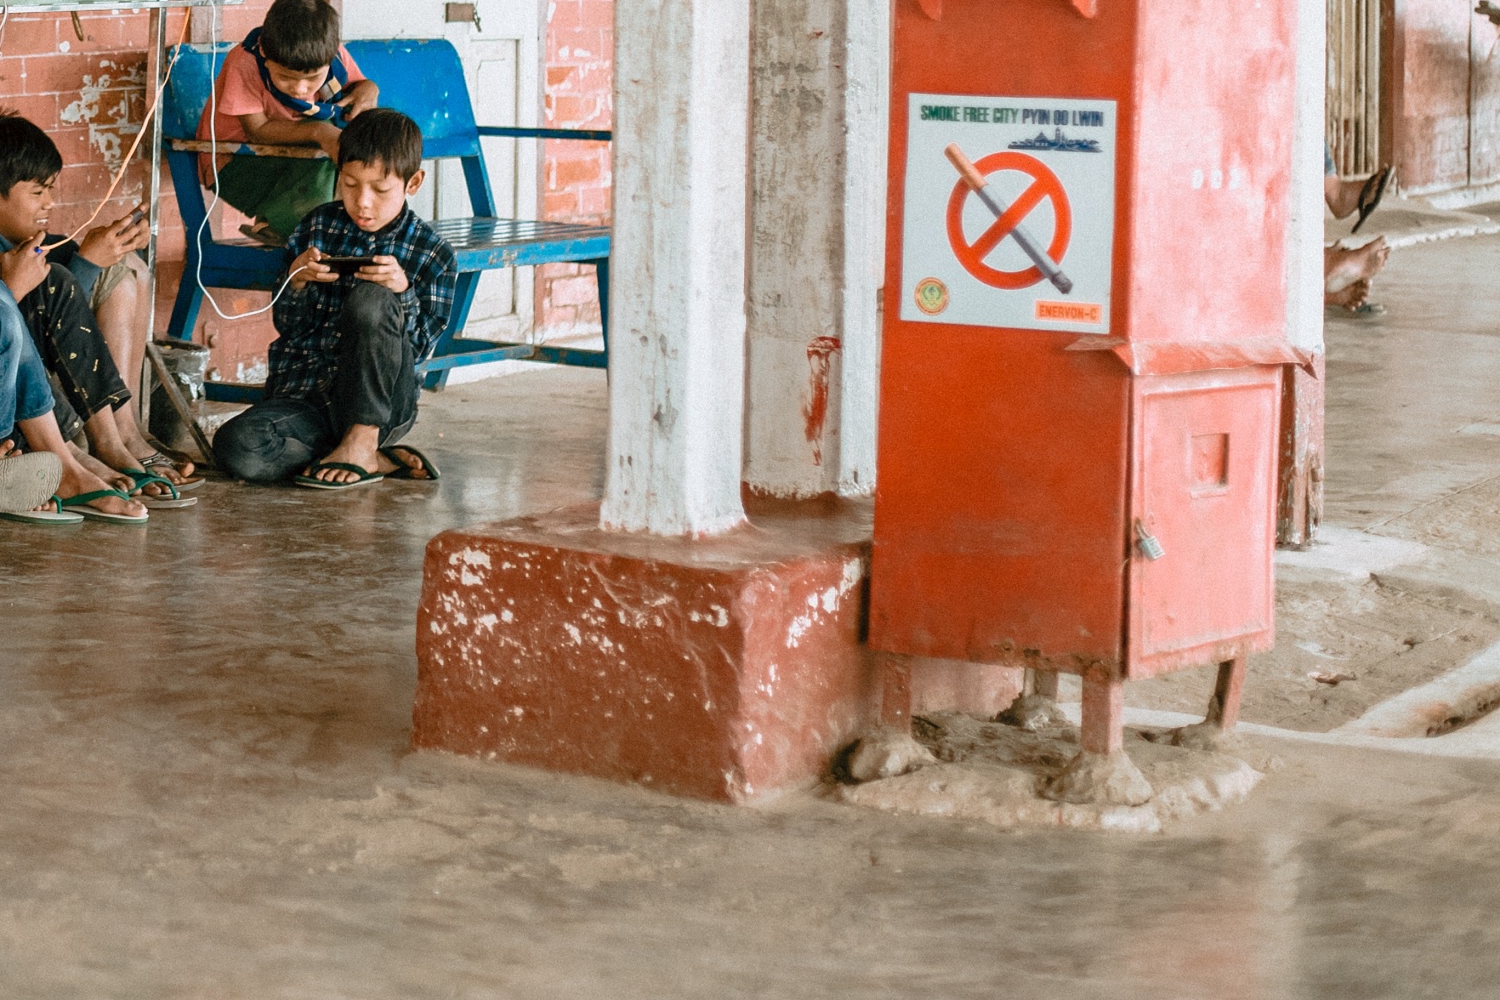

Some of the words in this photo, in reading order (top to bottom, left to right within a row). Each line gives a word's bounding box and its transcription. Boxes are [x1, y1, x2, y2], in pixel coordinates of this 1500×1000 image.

[920, 104, 961, 122] SMOKE
[963, 106, 990, 123] FREE
[992, 107, 1020, 124] CITY
[1022, 108, 1050, 125] PYIN
[1053, 109, 1069, 126] OO
[1072, 110, 1104, 127] LWIN
[1038, 304, 1098, 321] ENERVON-C
